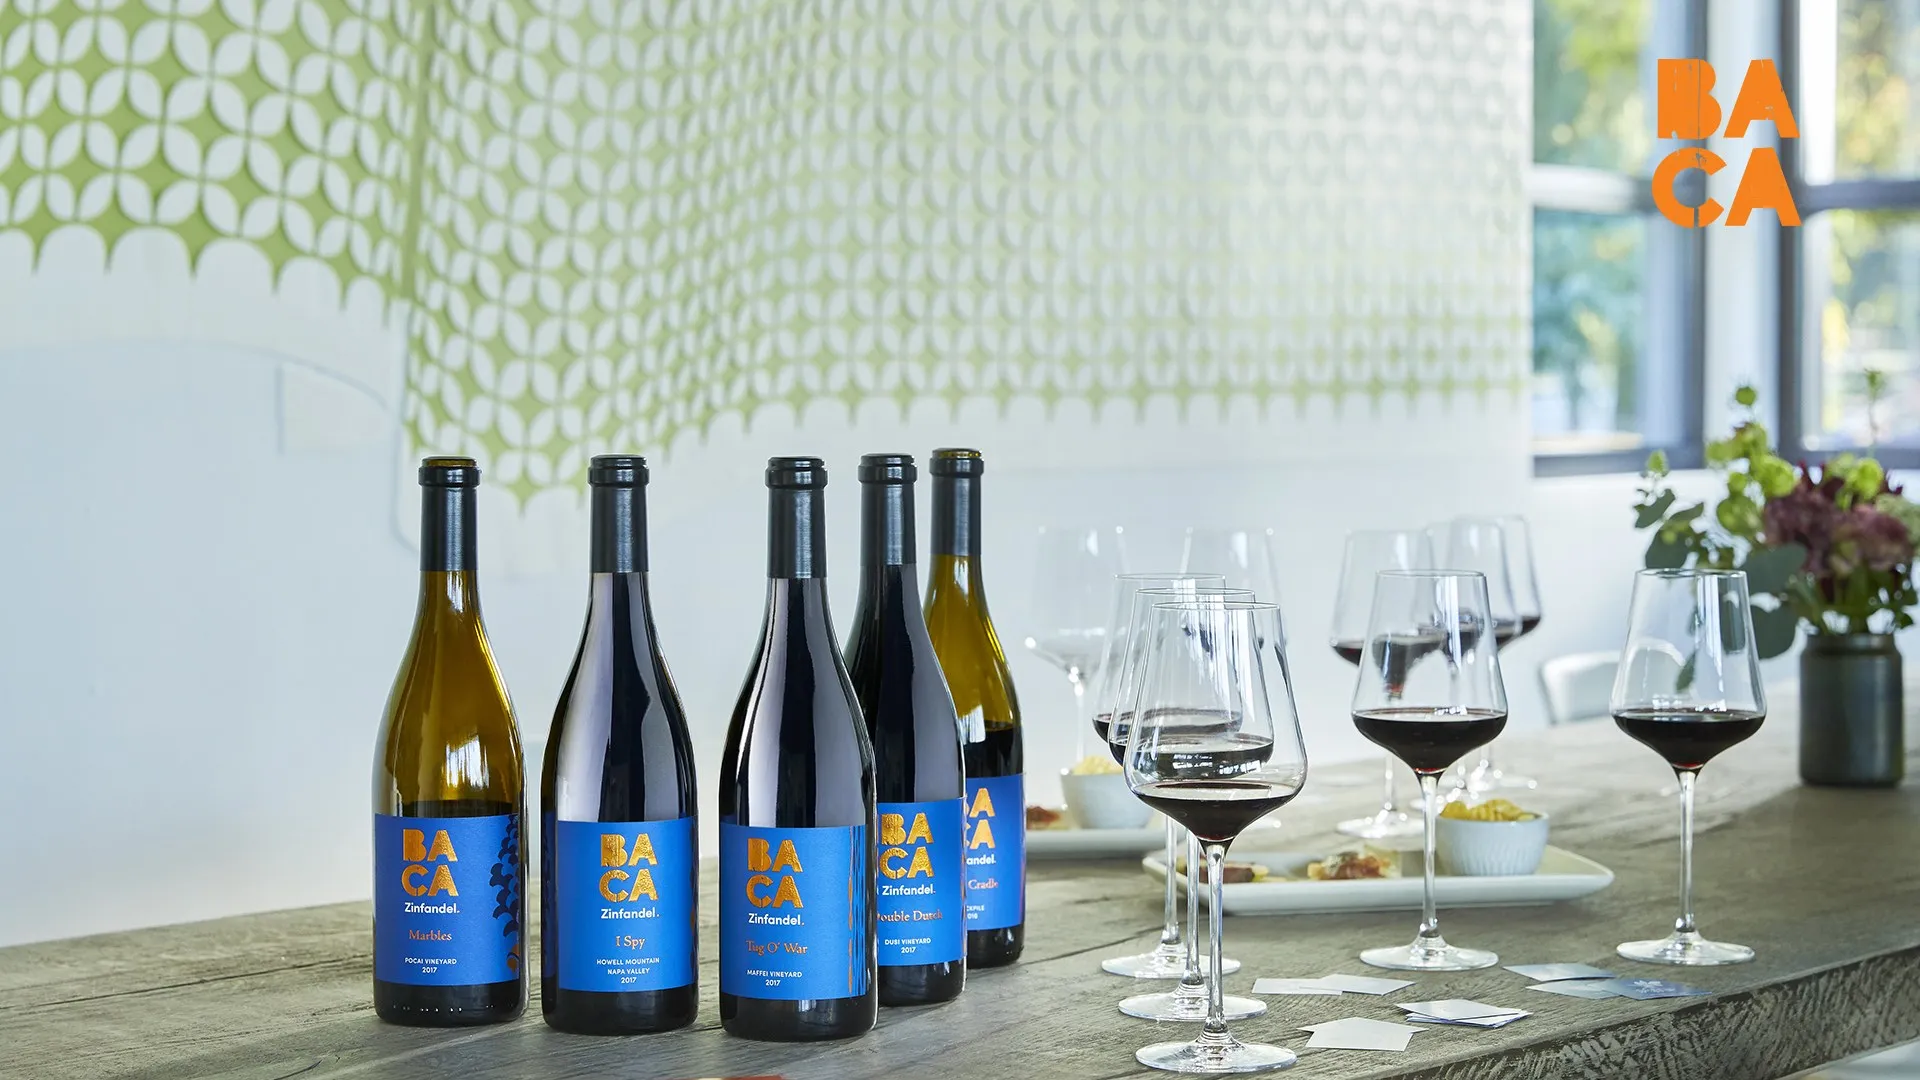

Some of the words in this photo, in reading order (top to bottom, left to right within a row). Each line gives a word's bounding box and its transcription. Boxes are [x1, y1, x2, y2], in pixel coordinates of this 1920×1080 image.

[965, 788, 996, 818] A
[881, 812, 935, 846] BA
[403, 829, 458, 862] BA
[601, 833, 658, 867] BA
[747, 837, 804, 872] BA
[879, 846, 935, 880] CA
[401, 864, 459, 897] CA
[599, 868, 659, 903] CA
[745, 874, 804, 909] CA
[882, 884, 936, 896] Zinfandel.
[404, 902, 460, 914] Zinfandel.
[600, 907, 660, 919] Zinfandel.
[748, 912, 805, 926] Zinfandel.
[913, 909, 943, 921] Dutch
[409, 929, 453, 941] Marbles
[901, 937, 932, 945] VINEYARD
[623, 935, 646, 950] Spy
[746, 939, 765, 956] Tug
[784, 942, 808, 954] War
[900, 946, 917, 954] 2017
[404, 957, 424, 965] POCAI
[596, 958, 624, 966] HOWELL
[625, 957, 660, 966] MOUNTAIN
[422, 966, 438, 974] 2017
[626, 967, 651, 975] VALLEY
[746, 969, 769, 977] MAFFEI
